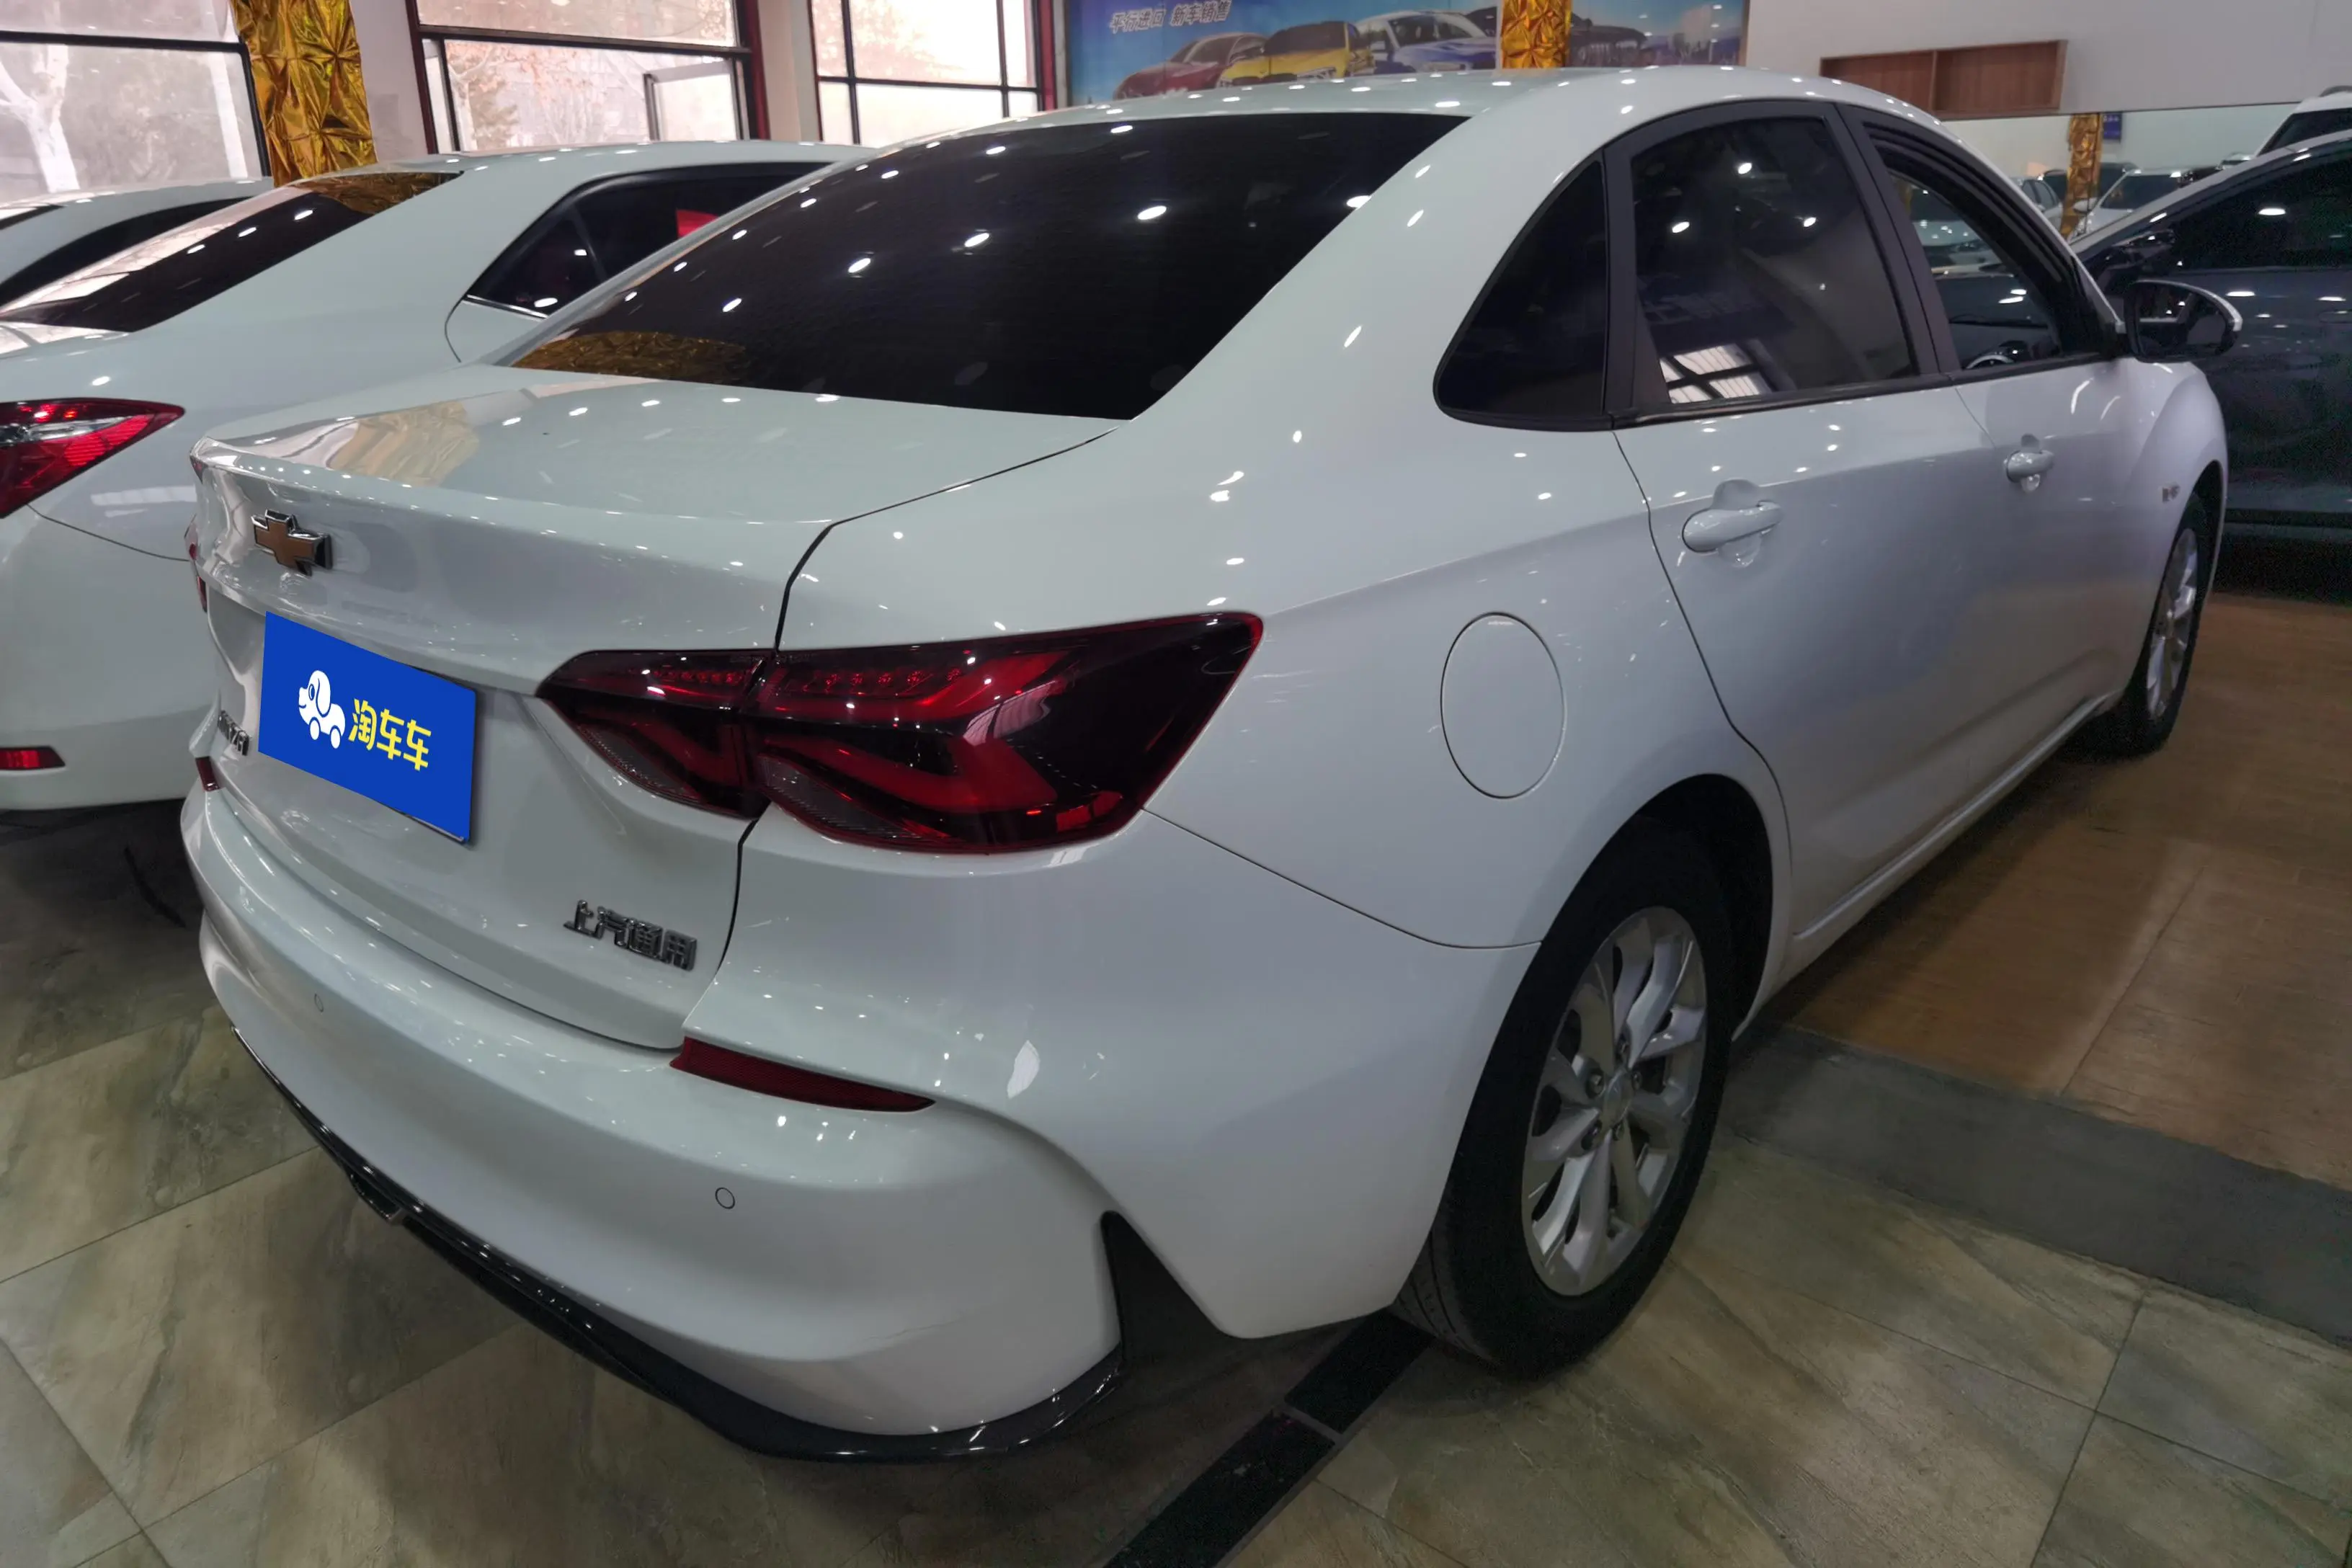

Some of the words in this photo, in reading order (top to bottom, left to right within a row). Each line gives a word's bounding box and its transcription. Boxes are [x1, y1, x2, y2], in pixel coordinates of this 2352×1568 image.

[1110, 9, 1167, 34] 平行进口
[1170, 0, 1232, 27] 新车销售
[563, 899, 698, 971] 上汽通用
